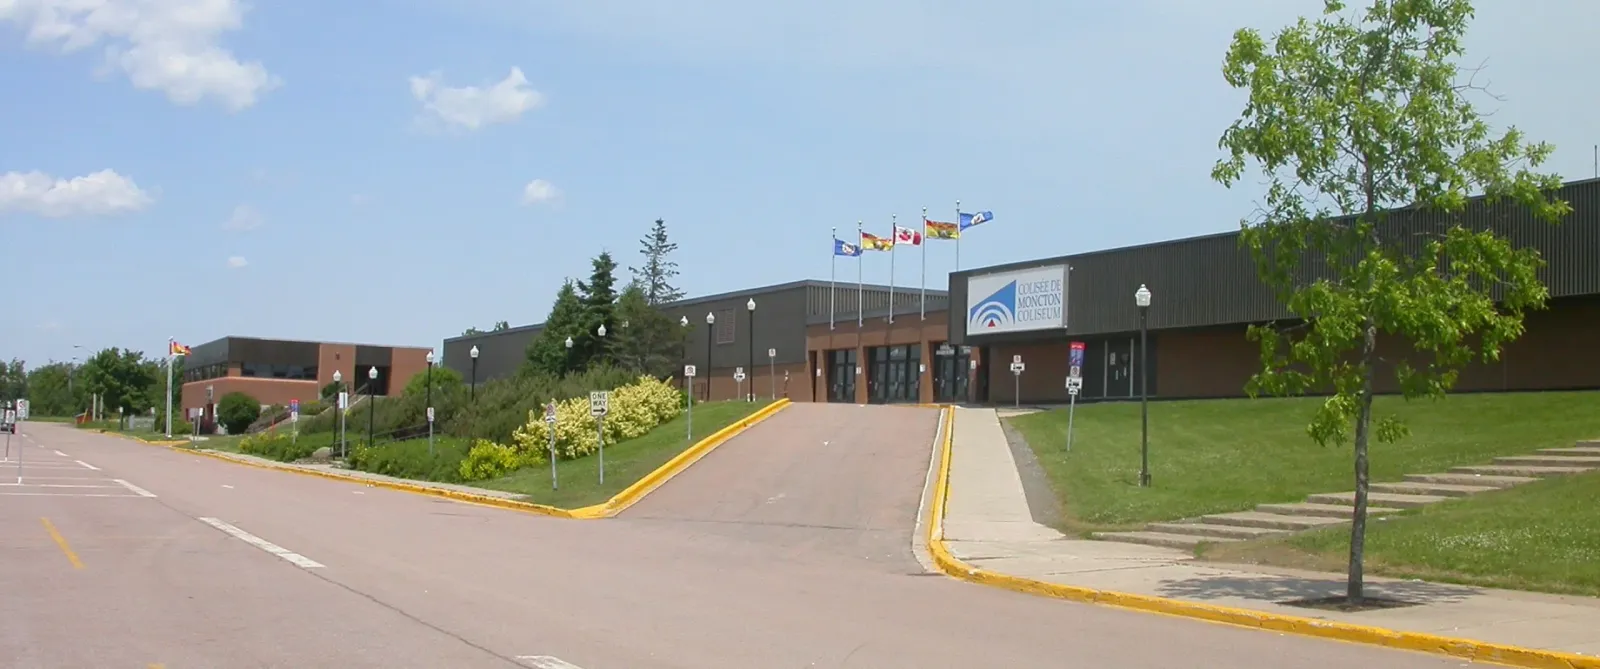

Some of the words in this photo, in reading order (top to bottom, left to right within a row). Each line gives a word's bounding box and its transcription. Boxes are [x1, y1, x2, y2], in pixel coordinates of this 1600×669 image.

[1018, 278, 1049, 295] COLISÉE
[1051, 279, 1061, 293] DE
[1018, 293, 1061, 308] MONCTON
[1018, 307, 1061, 322] COLISEUM
